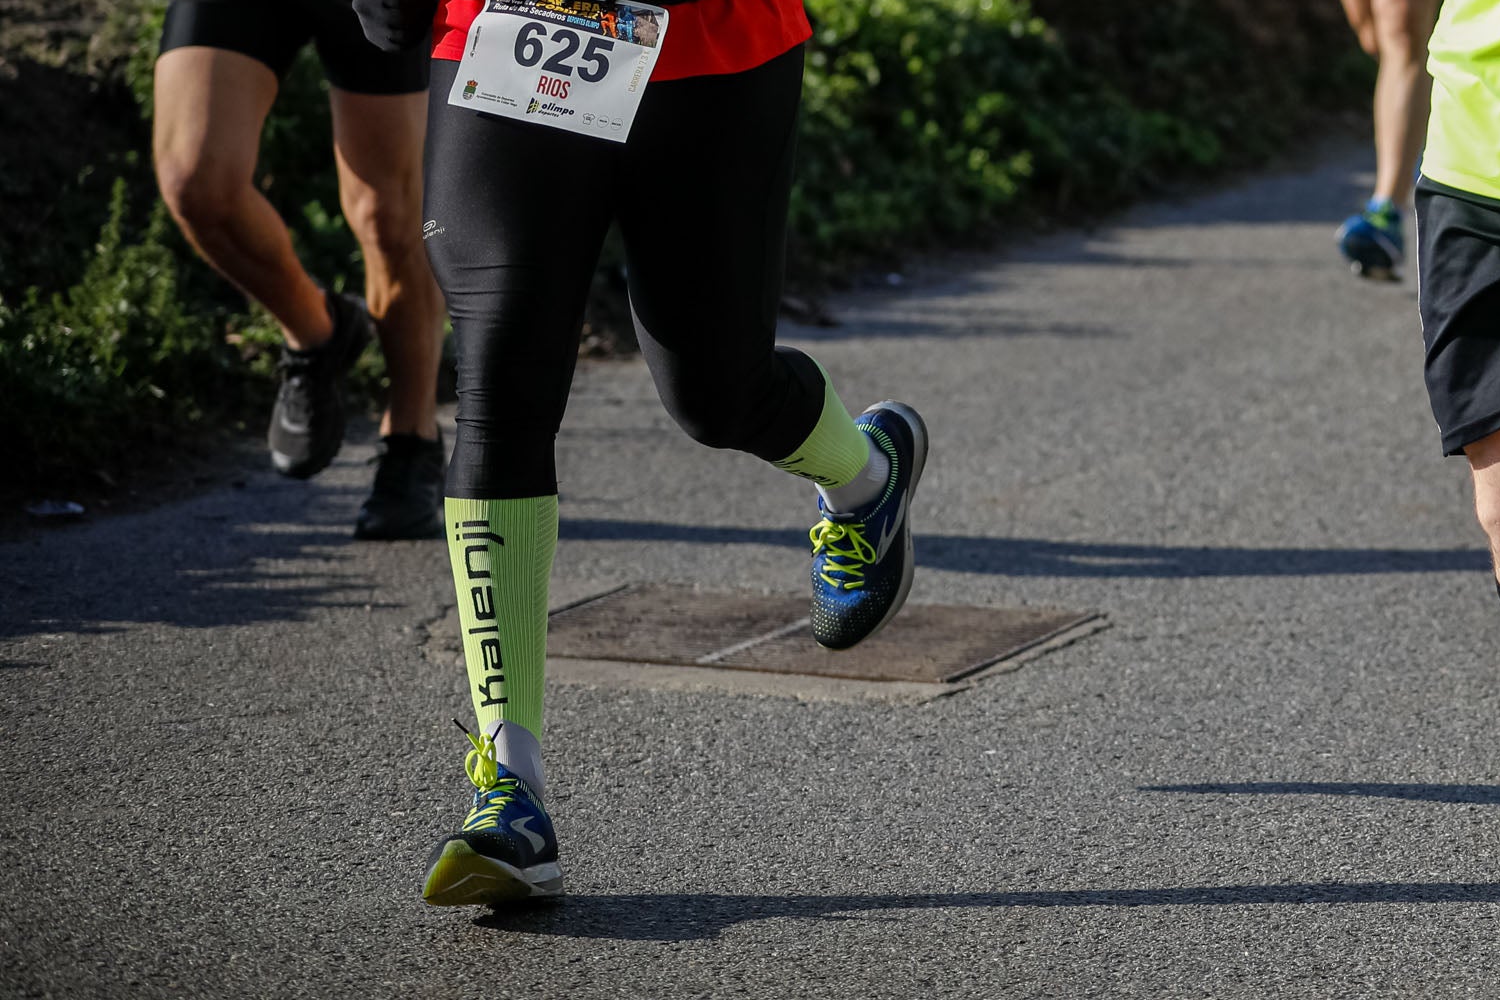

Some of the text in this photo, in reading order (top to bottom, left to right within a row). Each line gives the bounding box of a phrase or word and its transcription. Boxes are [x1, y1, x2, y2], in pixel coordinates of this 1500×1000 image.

[493, 3, 508, 11] Ruta
[529, 7, 566, 21] Secaderos
[514, 21, 615, 83] 625
[536, 75, 571, 100] RIOS
[541, 102, 575, 116] olimpo
[455, 520, 508, 707] kalenji
